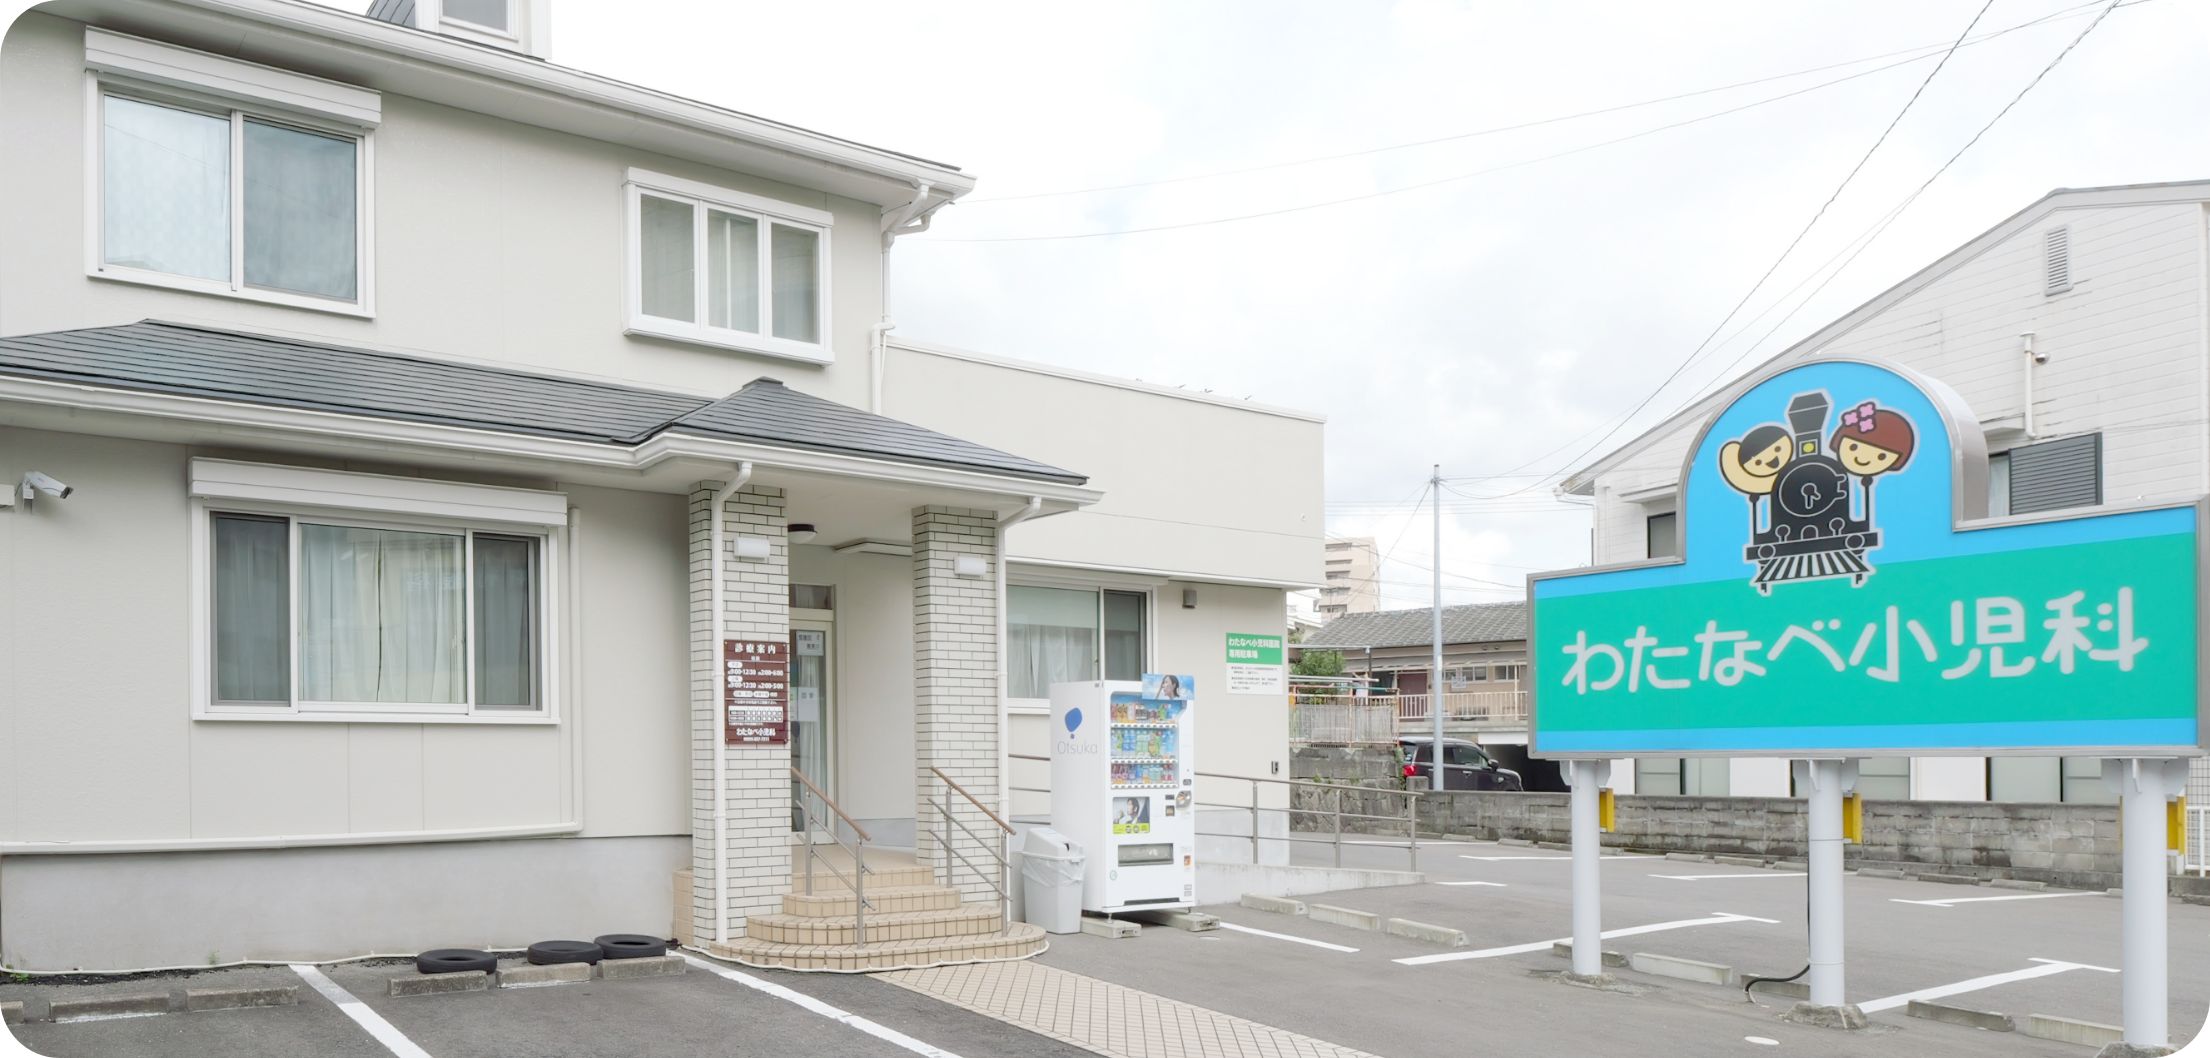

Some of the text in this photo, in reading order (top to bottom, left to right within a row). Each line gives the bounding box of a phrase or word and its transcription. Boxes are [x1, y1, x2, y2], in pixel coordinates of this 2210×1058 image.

[1561, 587, 2149, 695] わたなべ小児科
[1057, 740, 1098, 754] Otsuka
